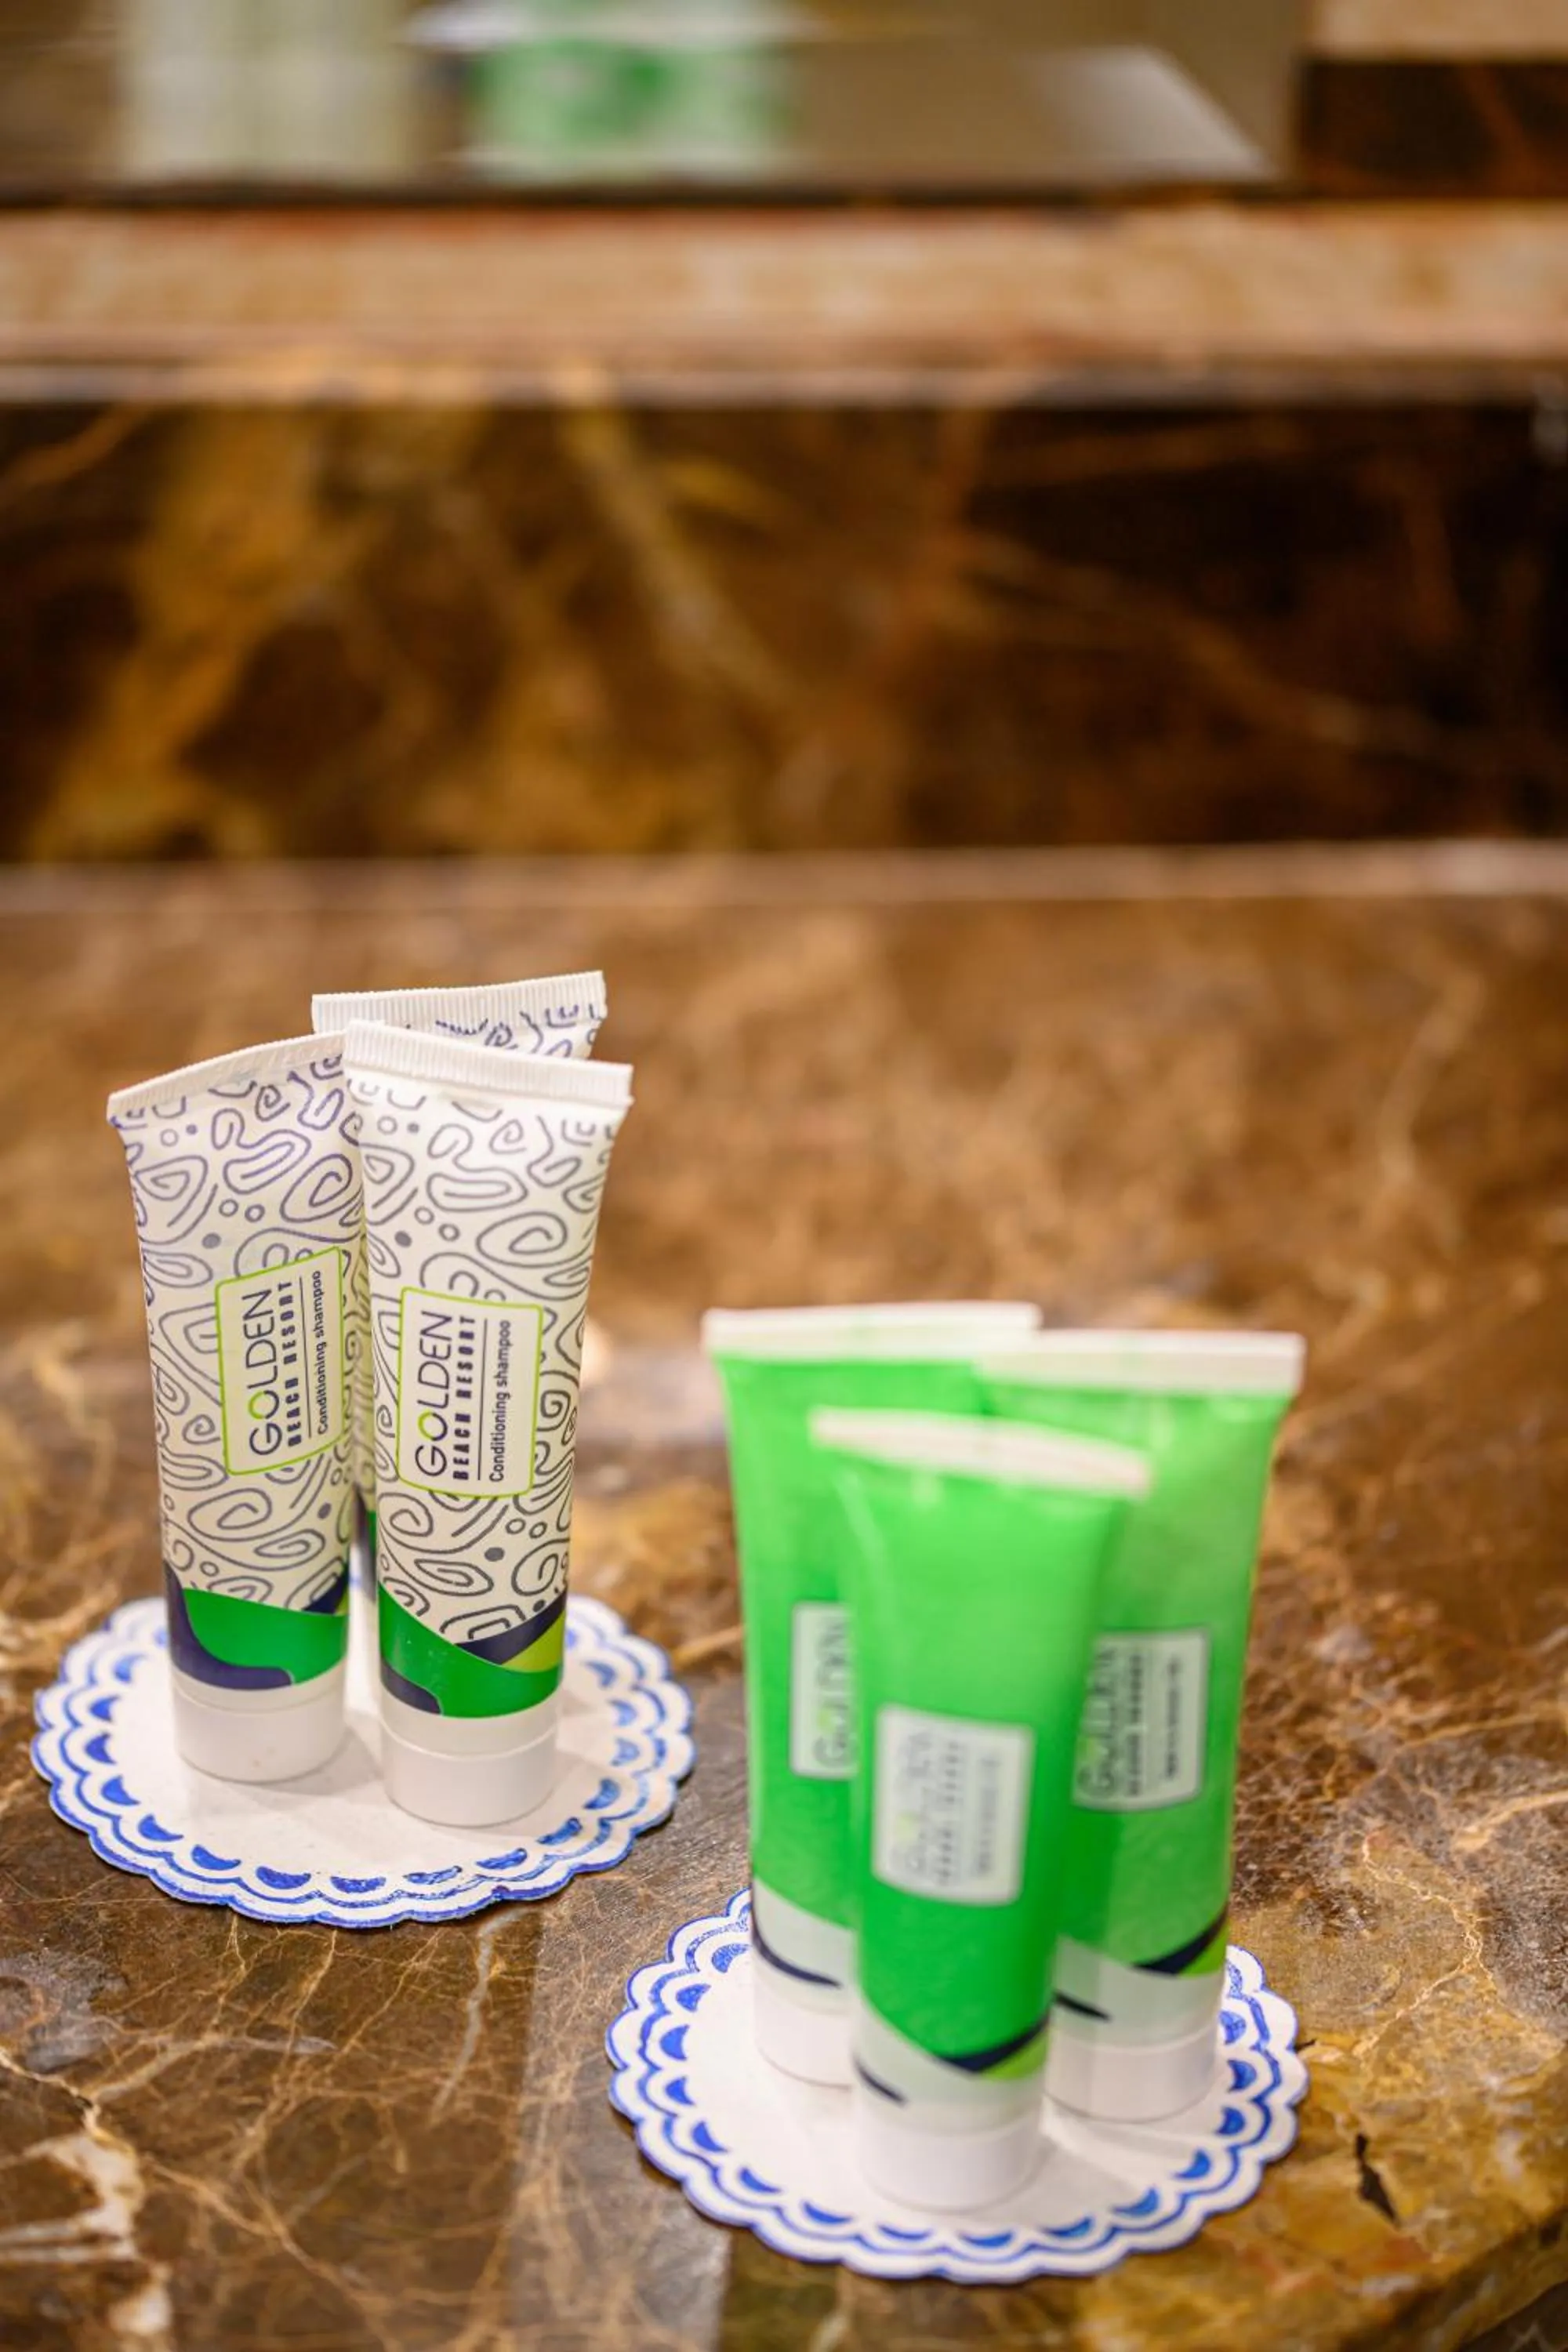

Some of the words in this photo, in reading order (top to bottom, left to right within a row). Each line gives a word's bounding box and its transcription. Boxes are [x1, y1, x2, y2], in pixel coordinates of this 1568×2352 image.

[278, 1280, 297, 1364] RESORT
[311, 1271, 325, 1338] shampoo
[242, 1289, 282, 1456] GOLDEN
[314, 1342, 328, 1435] Conditioning
[415, 1310, 452, 1477] GOLDEN
[456, 1316, 475, 1399] RESORT
[494, 1319, 514, 1387] shampoo
[285, 1377, 302, 1446] BEACH
[452, 1414, 470, 1480] BEACH
[489, 1392, 510, 1483] Conditioning
